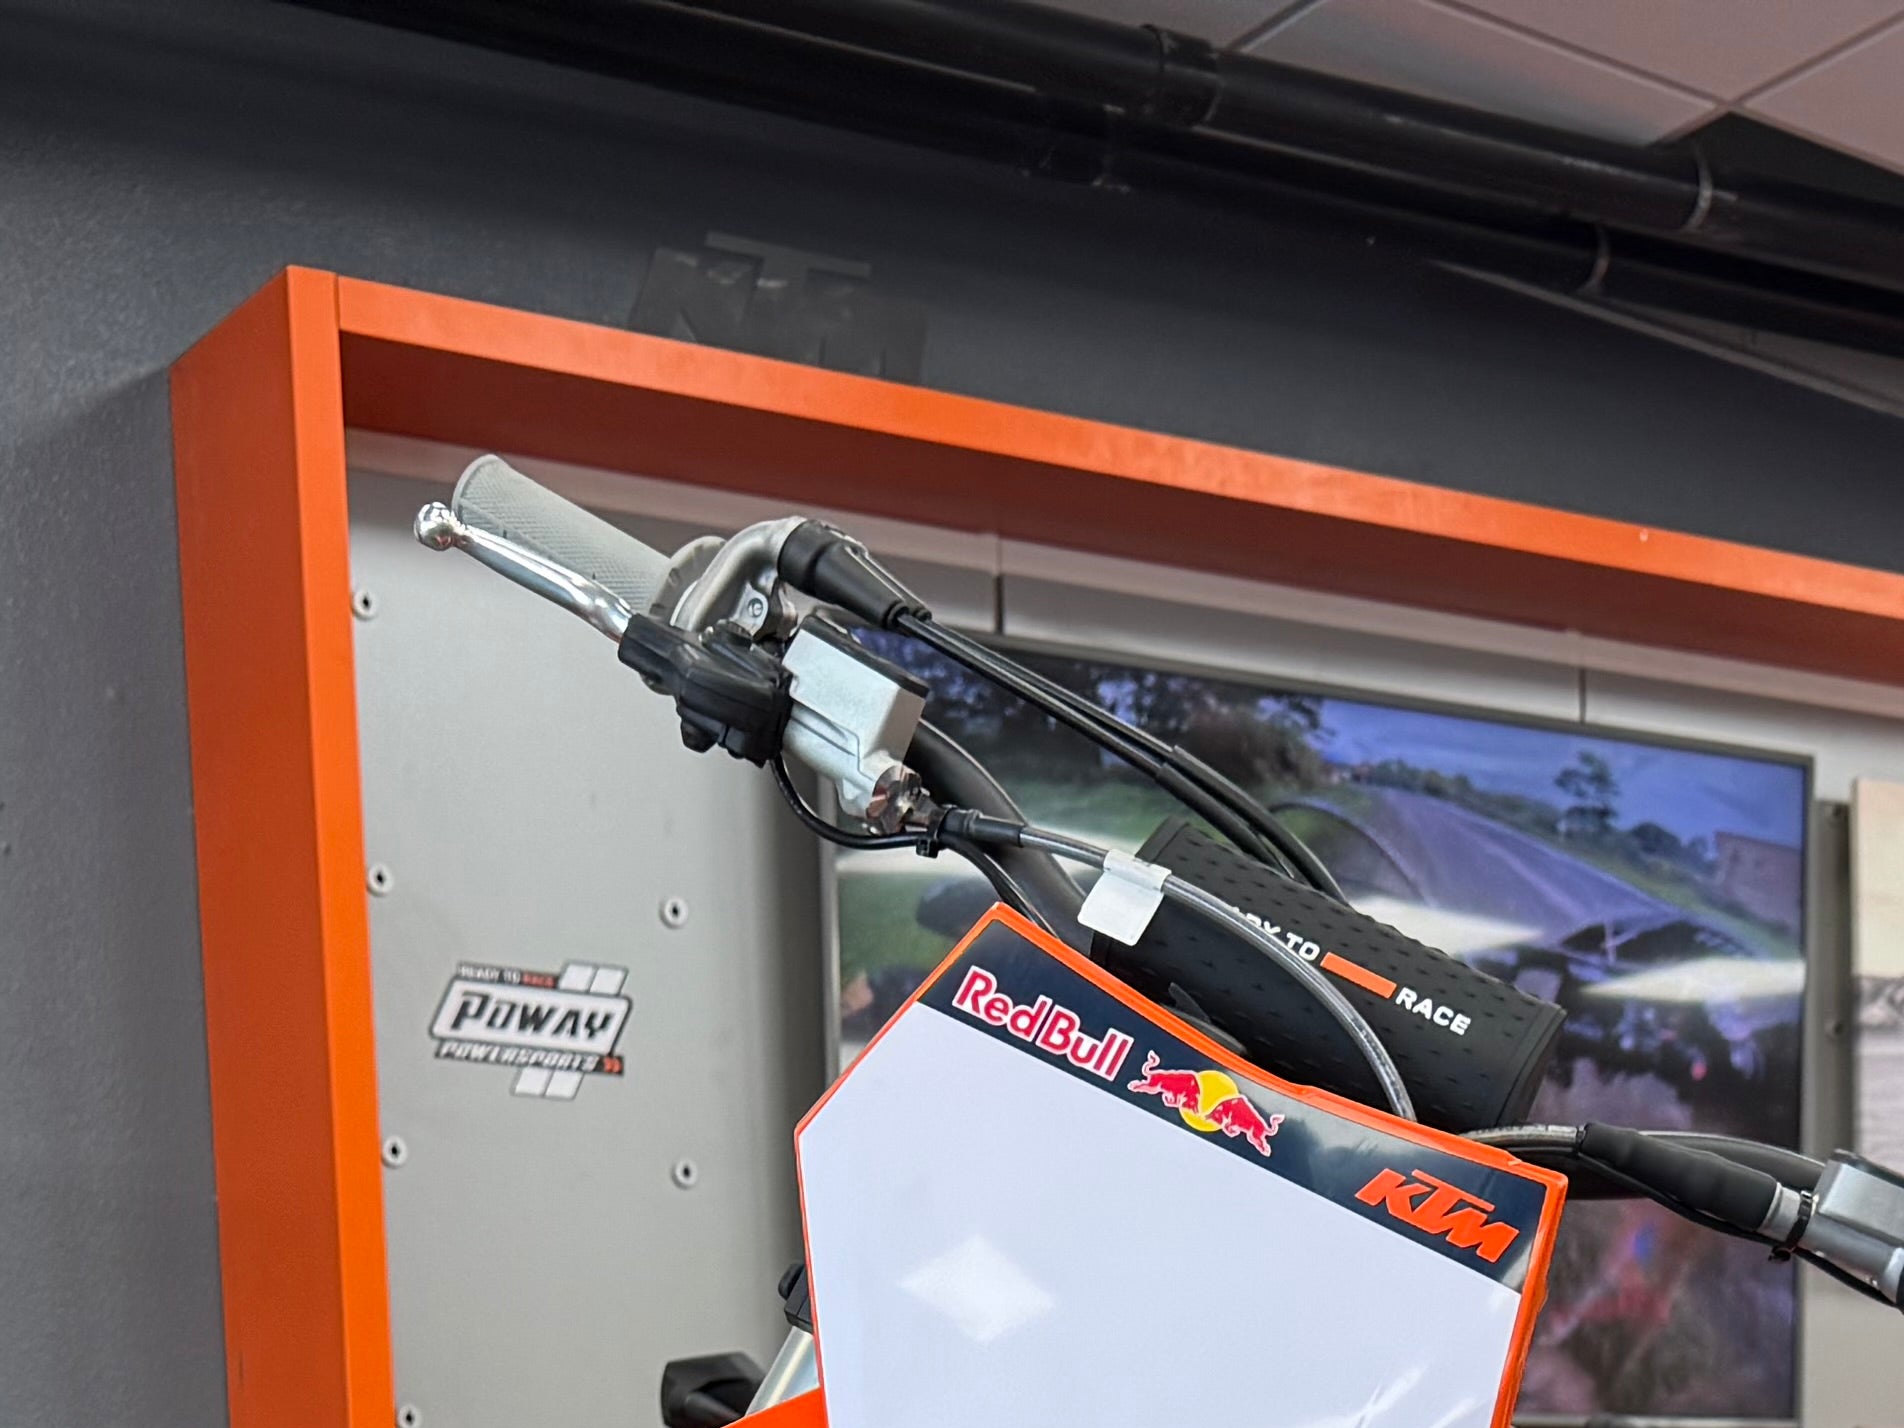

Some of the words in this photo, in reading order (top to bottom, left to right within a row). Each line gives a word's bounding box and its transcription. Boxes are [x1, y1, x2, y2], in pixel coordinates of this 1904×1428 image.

[953, 965, 1052, 1041] Red
[1036, 1005, 1134, 1081] Bull
[1286, 931, 1321, 961] TO
[1396, 986, 1472, 1037] RACE
[1354, 1168, 1520, 1263] KTM
